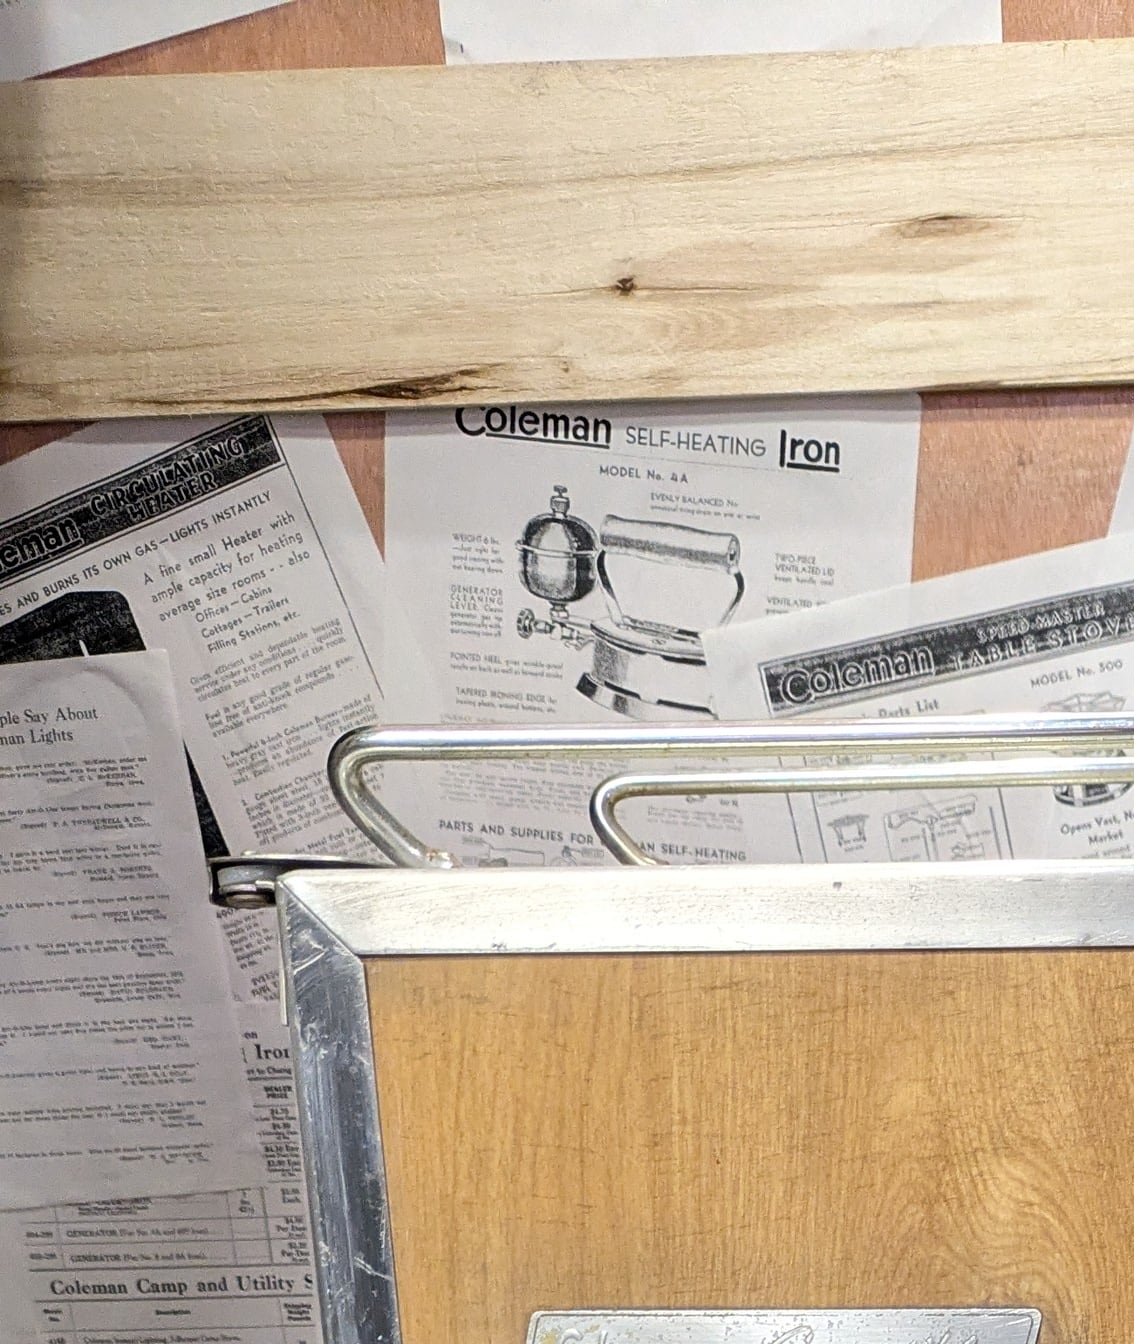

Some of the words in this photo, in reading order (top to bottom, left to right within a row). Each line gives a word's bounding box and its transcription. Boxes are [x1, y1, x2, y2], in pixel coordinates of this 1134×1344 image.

[455, 407, 613, 446] Coleman
[626, 426, 766, 457] SELF-HEATING
[779, 429, 841, 468] Iron
[90, 435, 247, 517] CIRCULATING
[599, 465, 641, 480] MODEL
[646, 470, 665, 482] No.
[682, 496, 724, 508] BALANCED
[0, 517, 82, 572] eman
[127, 471, 217, 522] HEATER
[17, 591, 39, 609] AND
[43, 574, 80, 597] BURNS
[82, 564, 100, 580] ITS
[103, 551, 132, 570] OWN
[211, 490, 272, 524] INSTANTLY
[143, 572, 154, 586] A
[159, 561, 182, 578] fine
[188, 543, 217, 567] small
[221, 526, 264, 552] Heater
[269, 512, 296, 532] with
[452, 533, 484, 544] WEIGHT
[151, 581, 184, 604] ample
[189, 560, 234, 588] capacity
[237, 550, 255, 567] for
[260, 531, 304, 558] heating
[775, 564, 821, 576] VENTILATED
[159, 598, 201, 623] average
[206, 586, 229, 603] size
[232, 569, 267, 590] rooms
[288, 550, 311, 567] also
[450, 584, 503, 596] GENERATOR
[194, 604, 229, 623] Offices
[241, 586, 273, 604] Cabins
[450, 594, 503, 606] CLEANING
[201, 616, 243, 640] Cottages
[252, 597, 290, 616] Trailers
[207, 637, 238, 654] Filling
[238, 620, 281, 644] Stations,
[781, 646, 936, 705] Coleman
[953, 636, 1037, 671] TABLE
[1031, 669, 1073, 689] MODEL
[1077, 665, 1096, 678] No.
[23, 708, 49, 725] Say
[55, 707, 98, 722] About
[916, 700, 940, 714] List
[30, 728, 74, 746] Lights
[439, 819, 473, 834] PARTS
[480, 822, 505, 836] AND
[511, 826, 564, 842] SUPPLIES
[570, 833, 594, 845] FOR
[1060, 823, 1092, 836] Opens
[1088, 830, 1124, 846] Market
[661, 843, 747, 861] SELF-HEATING
[50, 1280, 129, 1296] Coleman
[136, 1278, 188, 1296] Camp
[197, 1276, 229, 1294] and
[236, 1275, 296, 1294] Utility
